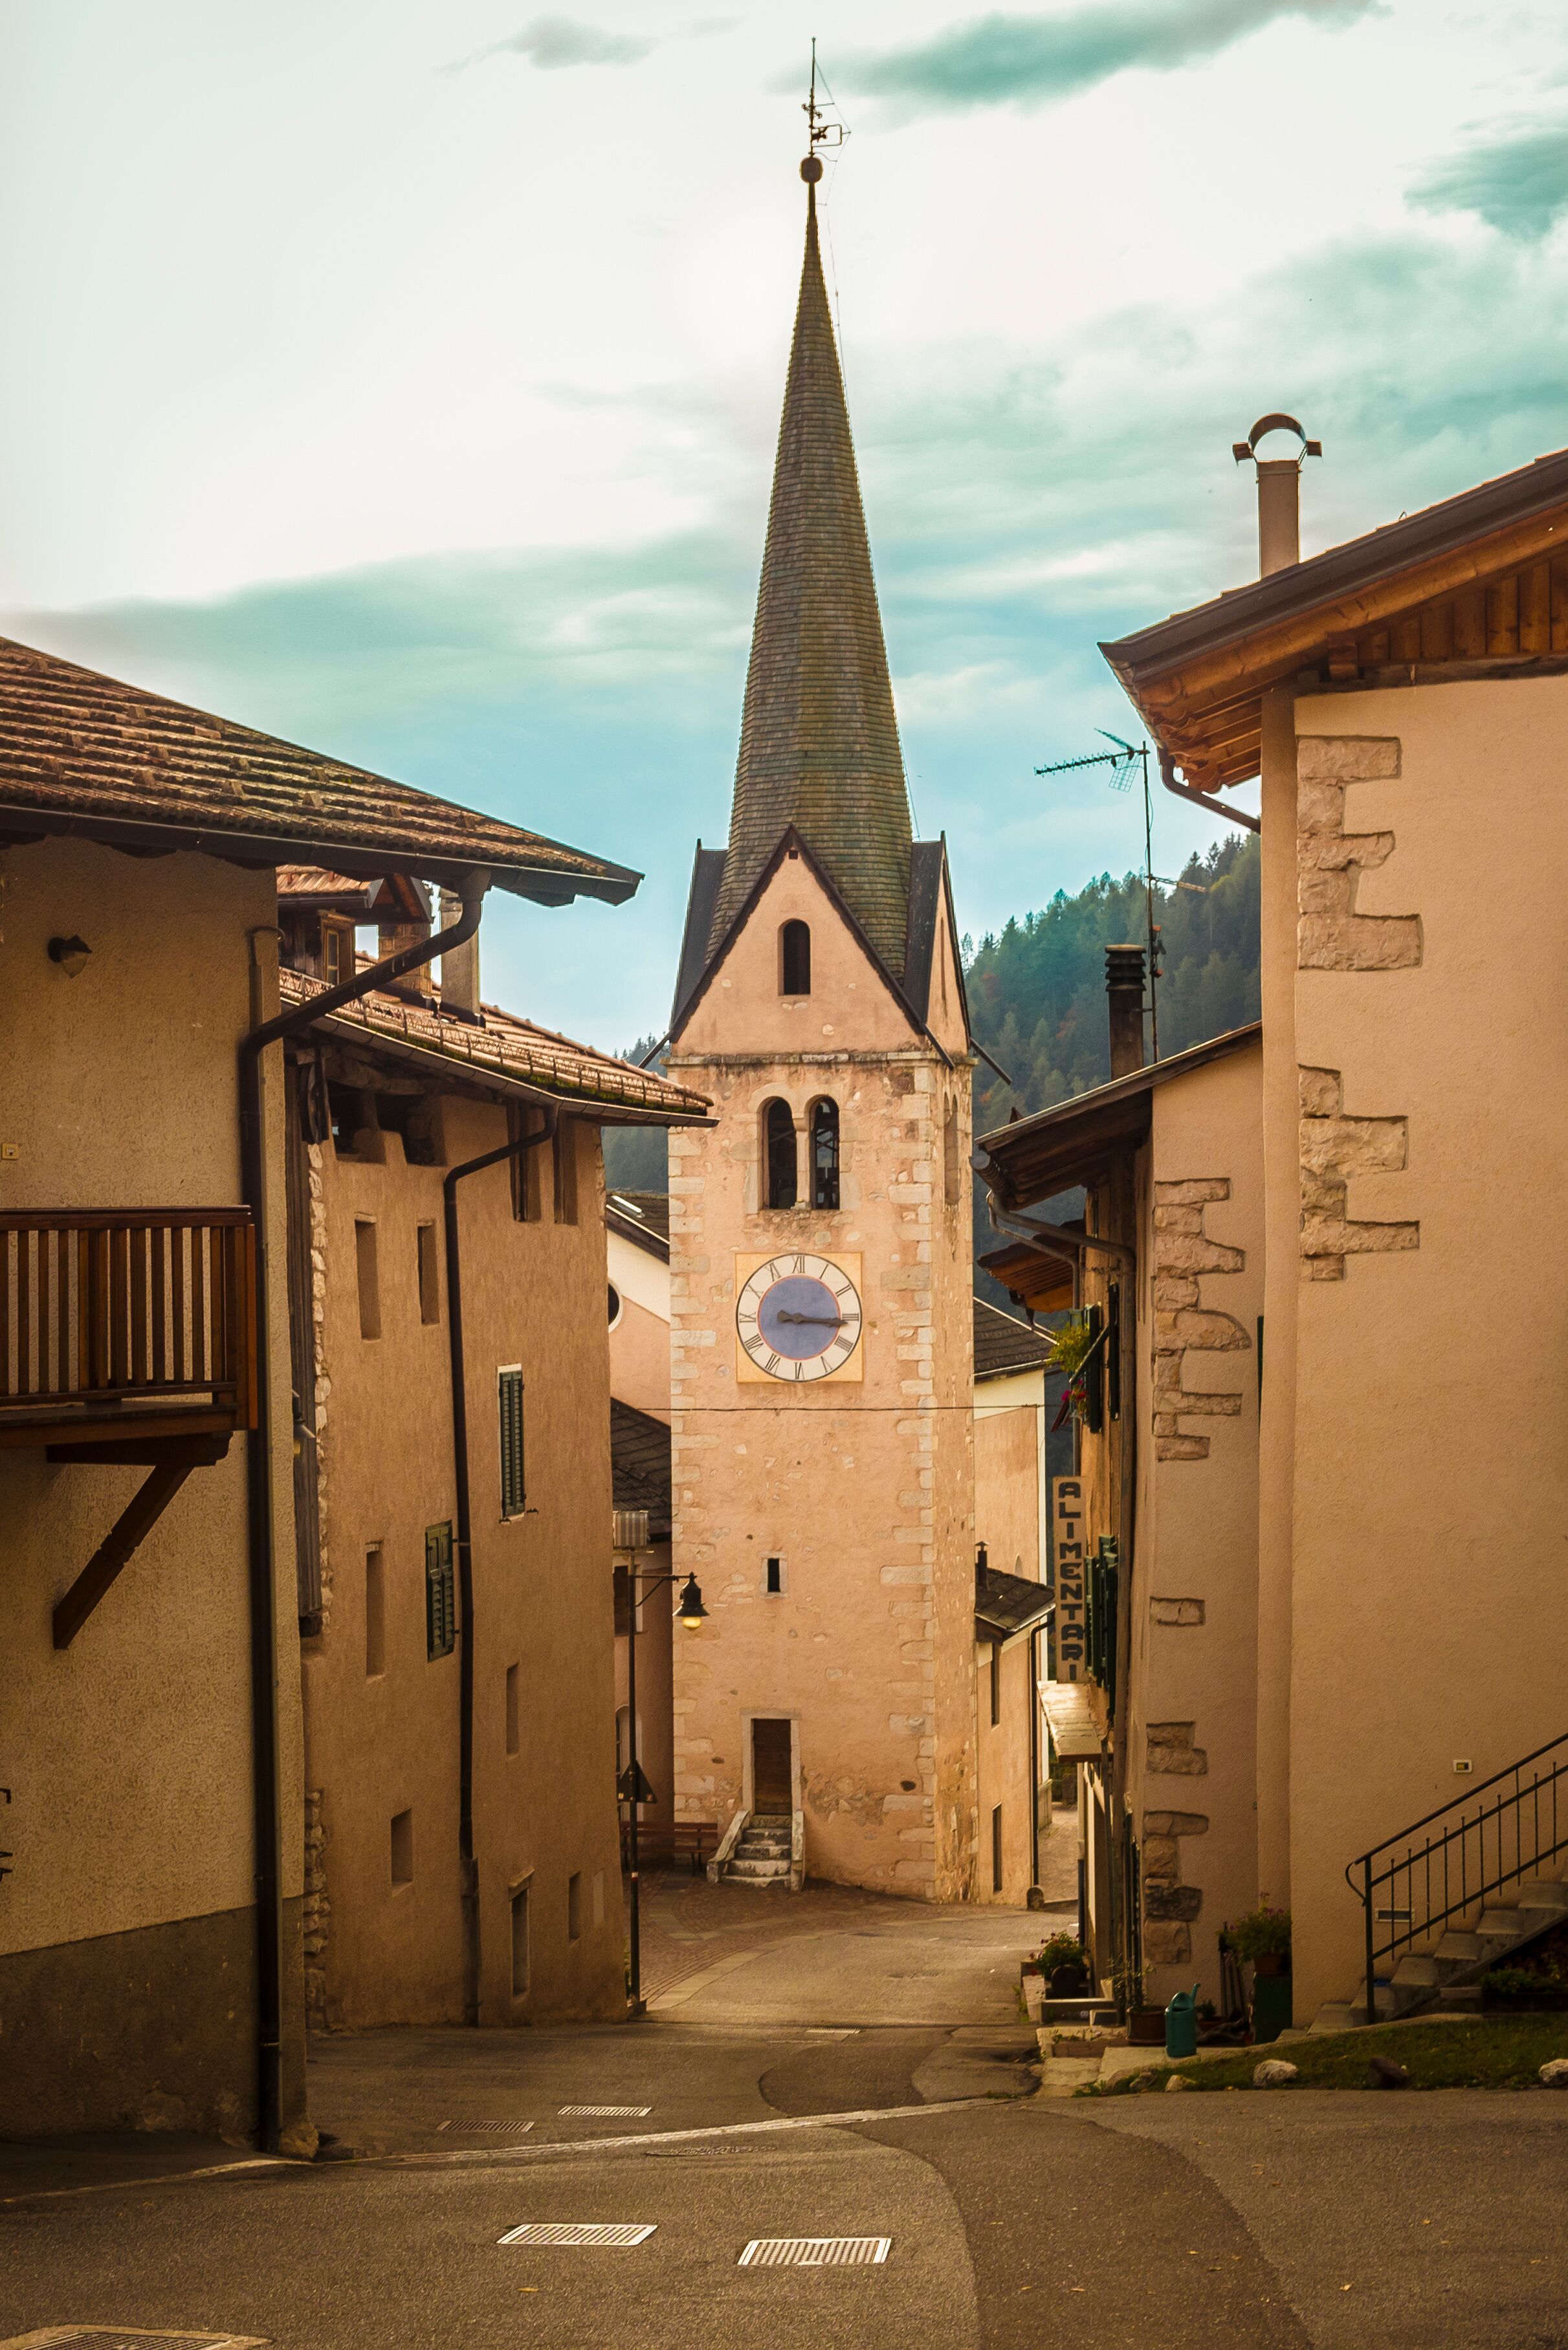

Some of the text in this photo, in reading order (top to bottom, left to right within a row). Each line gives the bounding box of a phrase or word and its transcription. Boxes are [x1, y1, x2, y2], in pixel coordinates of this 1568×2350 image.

[791, 1256, 806, 1274] XII
[794, 1362, 805, 1380] VI
[1058, 1481, 1084, 1681] ALIMENTARI
